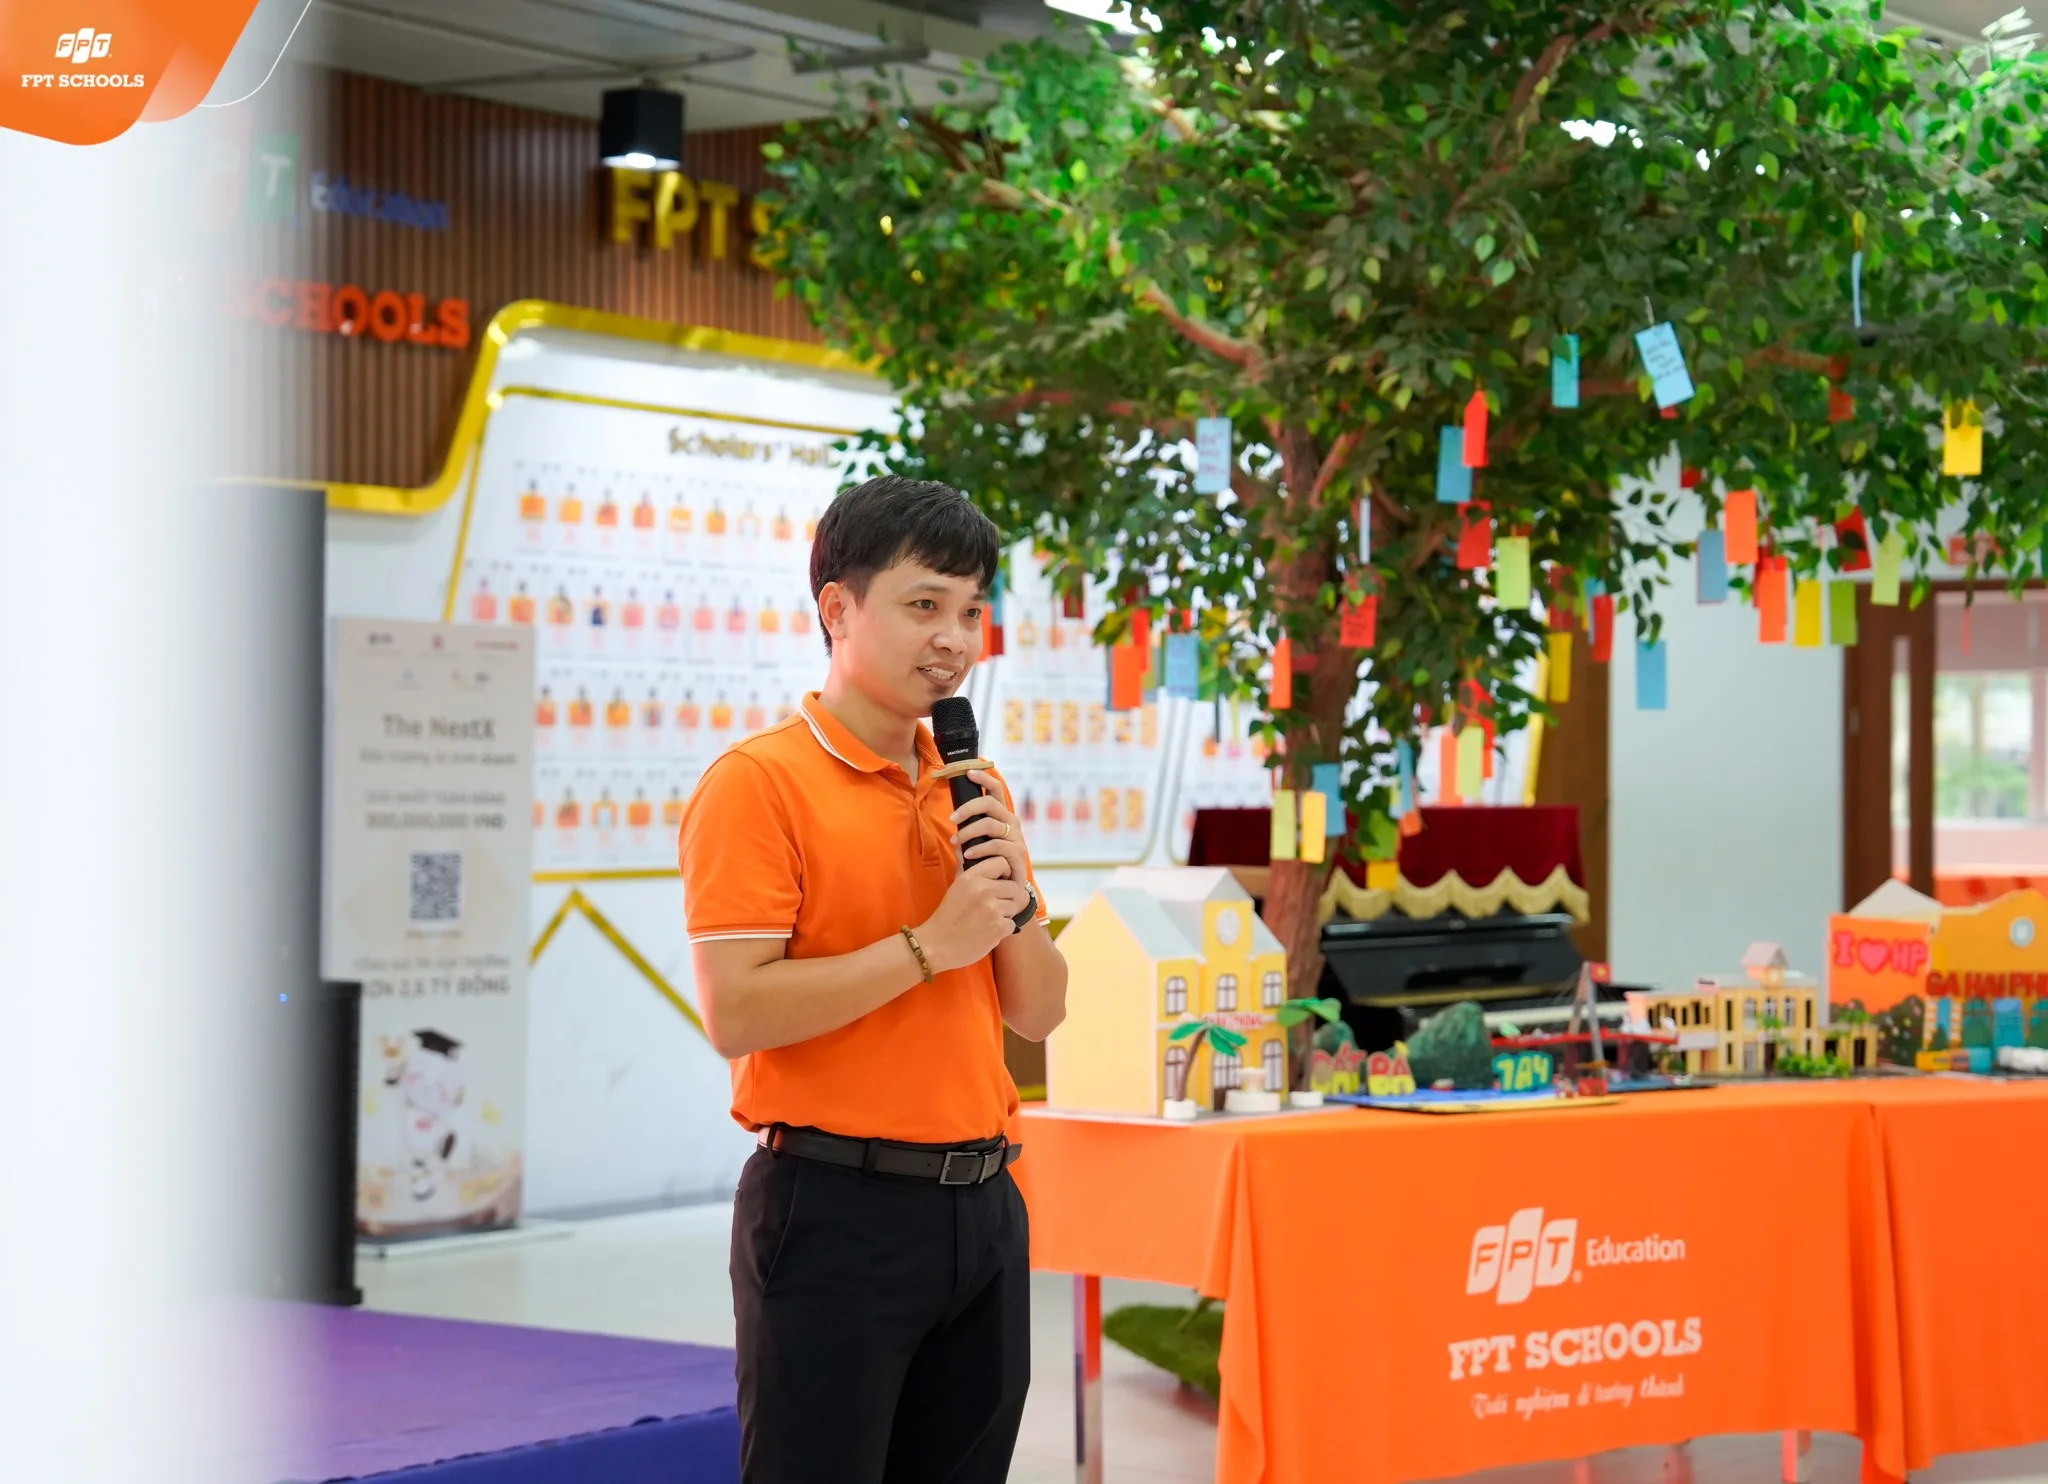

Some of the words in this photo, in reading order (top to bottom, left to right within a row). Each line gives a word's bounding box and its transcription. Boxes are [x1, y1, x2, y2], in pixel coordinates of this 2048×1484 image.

[612, 164, 738, 262] FPT
[1833, 930, 1855, 967] I
[1891, 936, 1929, 977] HP
[1466, 1207, 1578, 1304] FPT
[1586, 1234, 1686, 1267] Education
[1448, 1335, 1516, 1380] FPT
[1524, 1317, 1702, 1369] SCHOOLS
